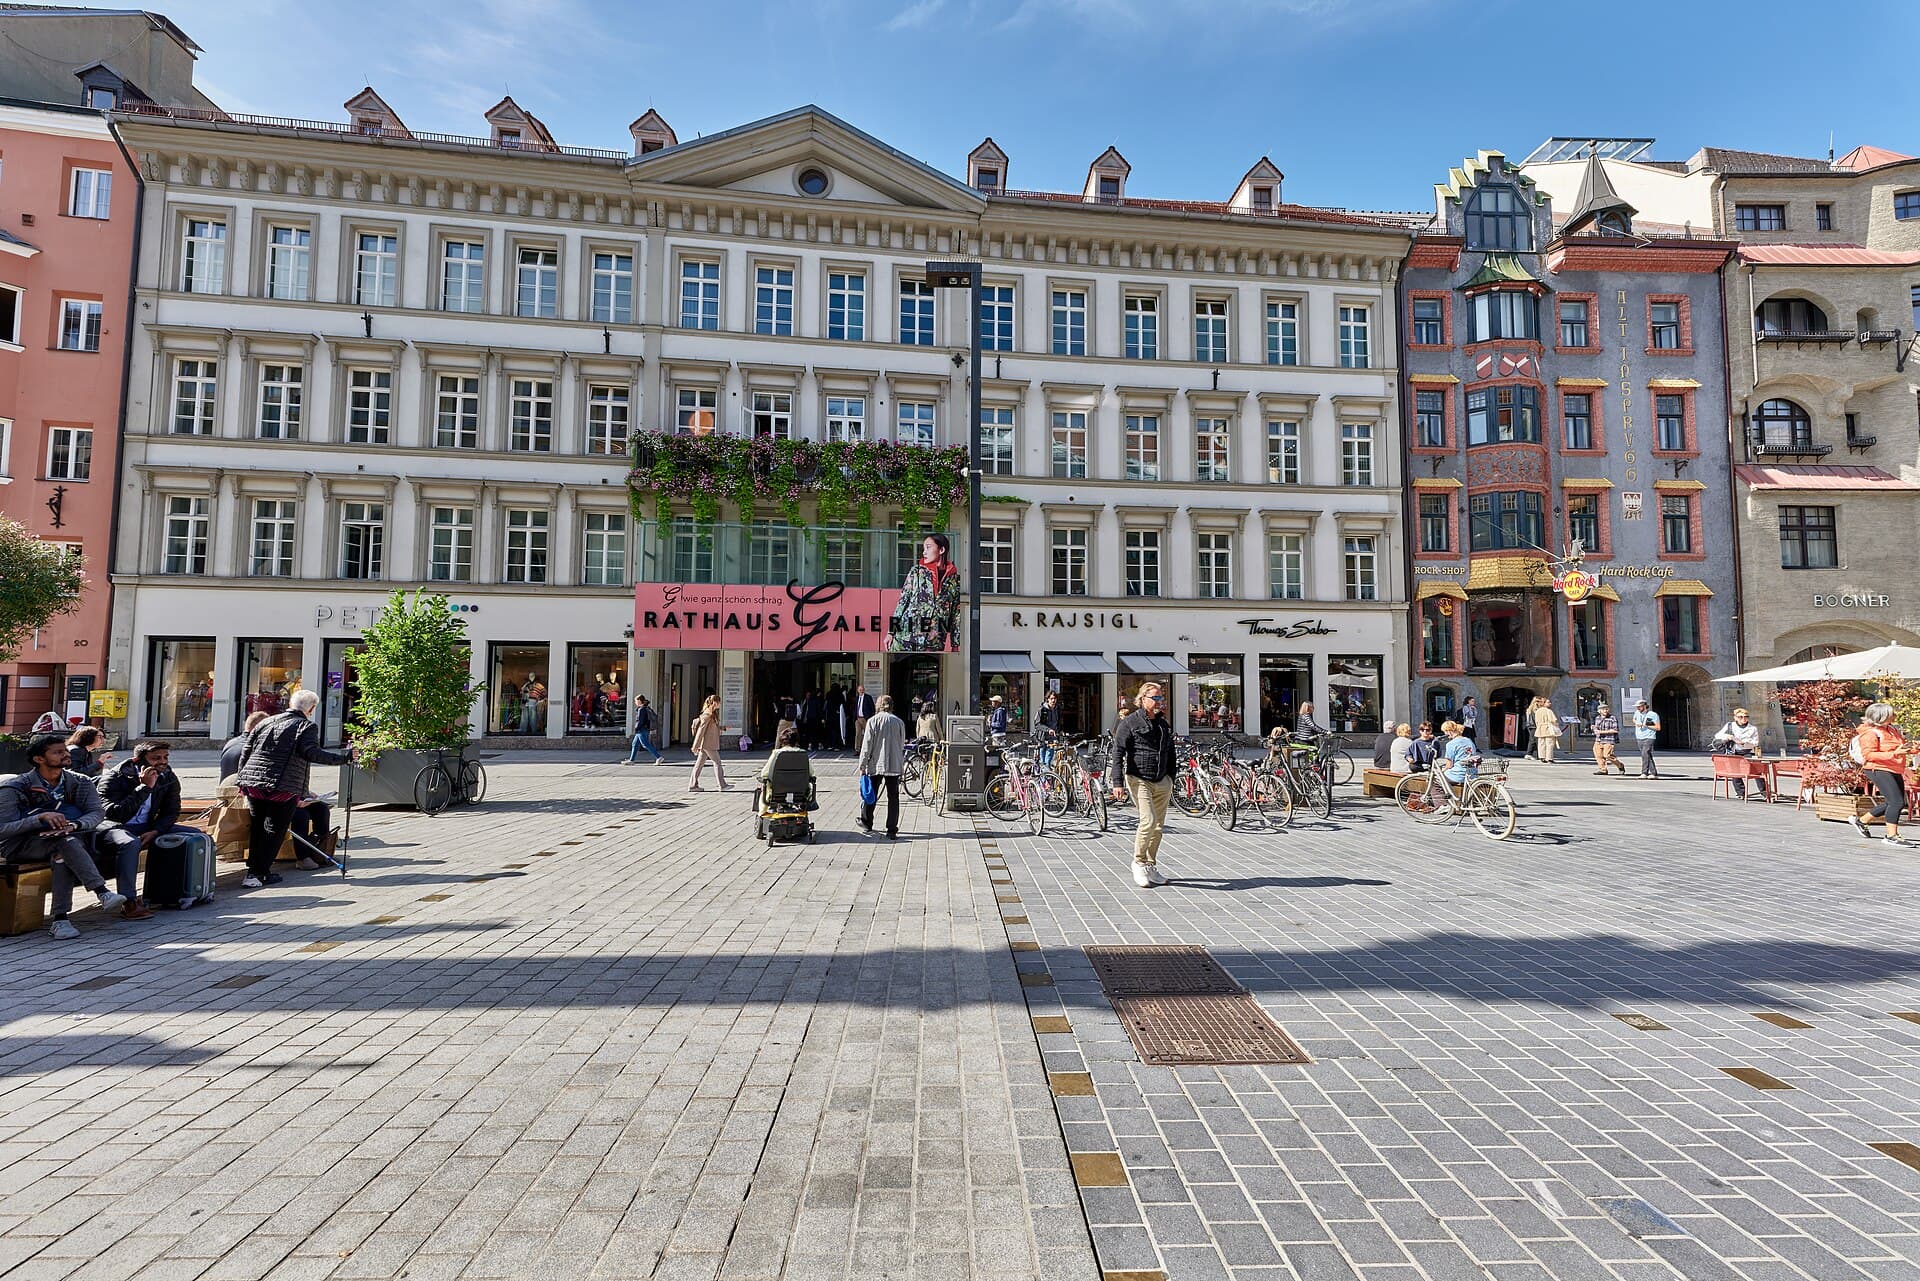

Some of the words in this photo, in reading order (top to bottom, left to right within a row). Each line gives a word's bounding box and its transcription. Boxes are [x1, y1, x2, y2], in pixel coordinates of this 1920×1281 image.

[1617, 290, 1628, 337] ALT
[1599, 565, 1625, 577] Hard
[1627, 565, 1650, 579] Rock
[1652, 565, 1674, 579] Cafe
[1553, 578, 1573, 591] Hard
[1574, 574, 1595, 589] Rock
[684, 595, 699, 604] wie
[700, 597, 722, 605] ganz
[1814, 594, 1890, 608] BOGNER
[643, 611, 781, 631] RATHAUS
[1012, 611, 1028, 627] R.
[1037, 612, 1139, 629] RAJSIGL
[1237, 618, 1289, 638] Thomas
[1285, 619, 1338, 639] Sabo
[73, 639, 89, 648] 20
